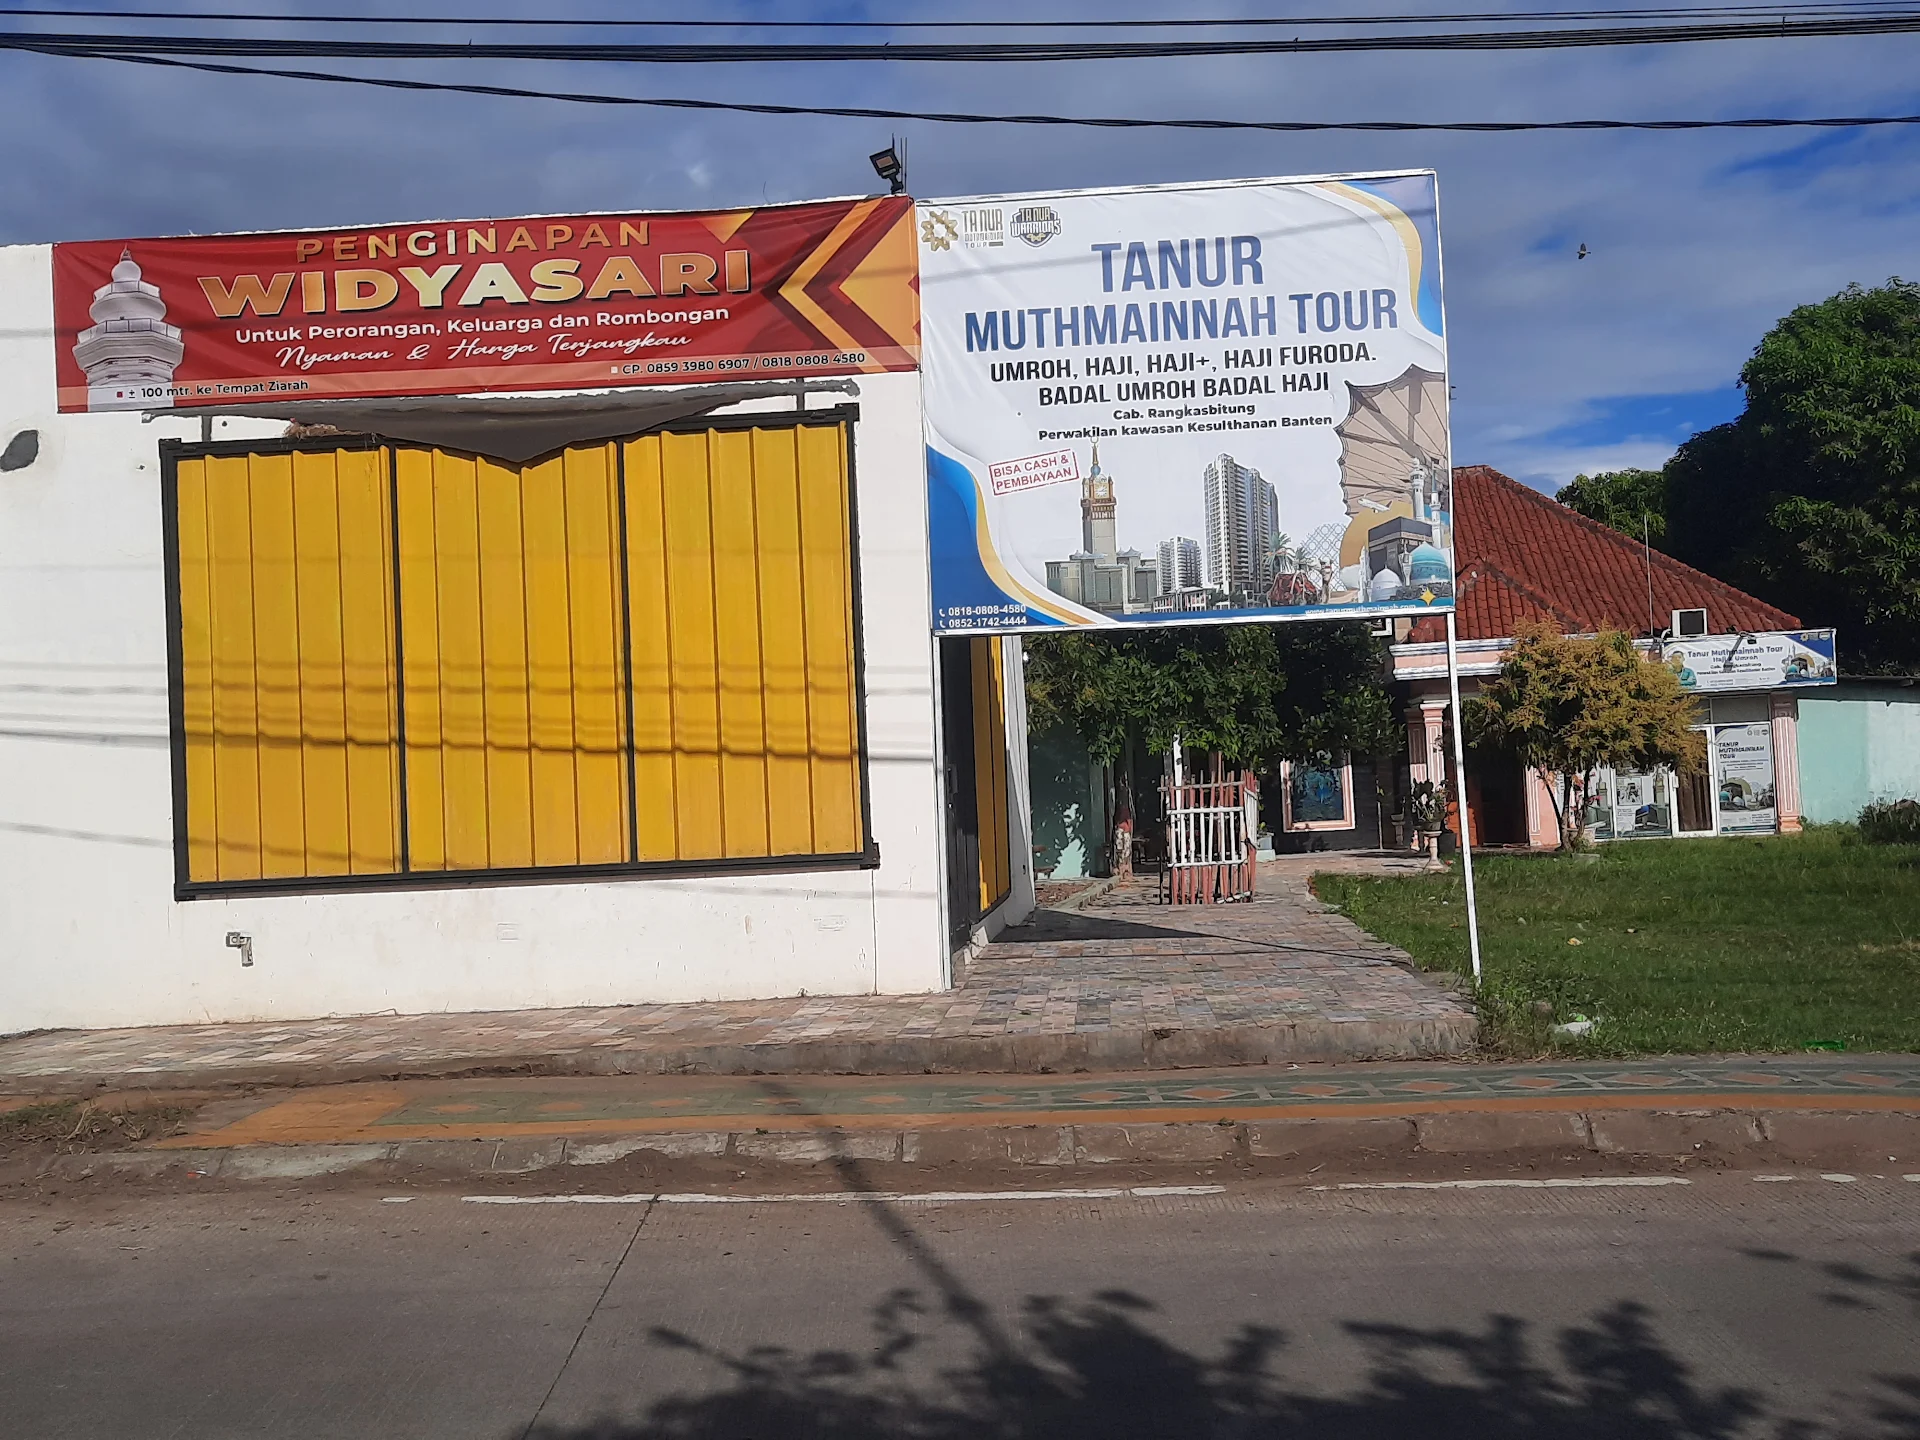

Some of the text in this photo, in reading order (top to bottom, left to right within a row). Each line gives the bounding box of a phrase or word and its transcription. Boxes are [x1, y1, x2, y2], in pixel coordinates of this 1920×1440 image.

[961, 208, 1003, 232] TANUR
[1020, 206, 1051, 221] TANUR
[1010, 219, 1062, 236] WARRIORS
[296, 220, 651, 264] PENGINAPAN
[1090, 234, 1264, 292] TANUR
[197, 250, 751, 318] WIDYASARI
[235, 306, 730, 344] Untuk Perorangan, Keluarga dan Rombongan
[964, 288, 1398, 352] MUTHMAINNAH TOUR
[275, 331, 693, 370] Nyaman & Harga Terjangkau
[990, 342, 1377, 382] UMROH, HAJI, HAJI+, HAJI FURODA.
[622, 352, 866, 375] CP. 0859 3980 6907 / 0818 0808 4580
[141, 388, 163, 398] 100
[166, 386, 193, 397] mtr.
[196, 385, 212, 395] ke
[215, 382, 265, 396] Tempat
[267, 379, 309, 391] Ziarah
[1039, 371, 1329, 406] BADAL UMROH BADAL HAJI
[1112, 403, 1256, 420] Cab. Rangkasbitung
[1038, 416, 1333, 441] Perwakilan kawasan Kesulthanan Banten
[993, 454, 1069, 478] BISA CASH &
[996, 467, 1072, 490] PEMBIAYAAN
[948, 604, 1027, 616] 0818-0808-4580
[948, 615, 1027, 628] 0852-1742-4444
[1687, 650, 1709, 658] Tanur
[1711, 647, 1765, 657] Muthainnah
